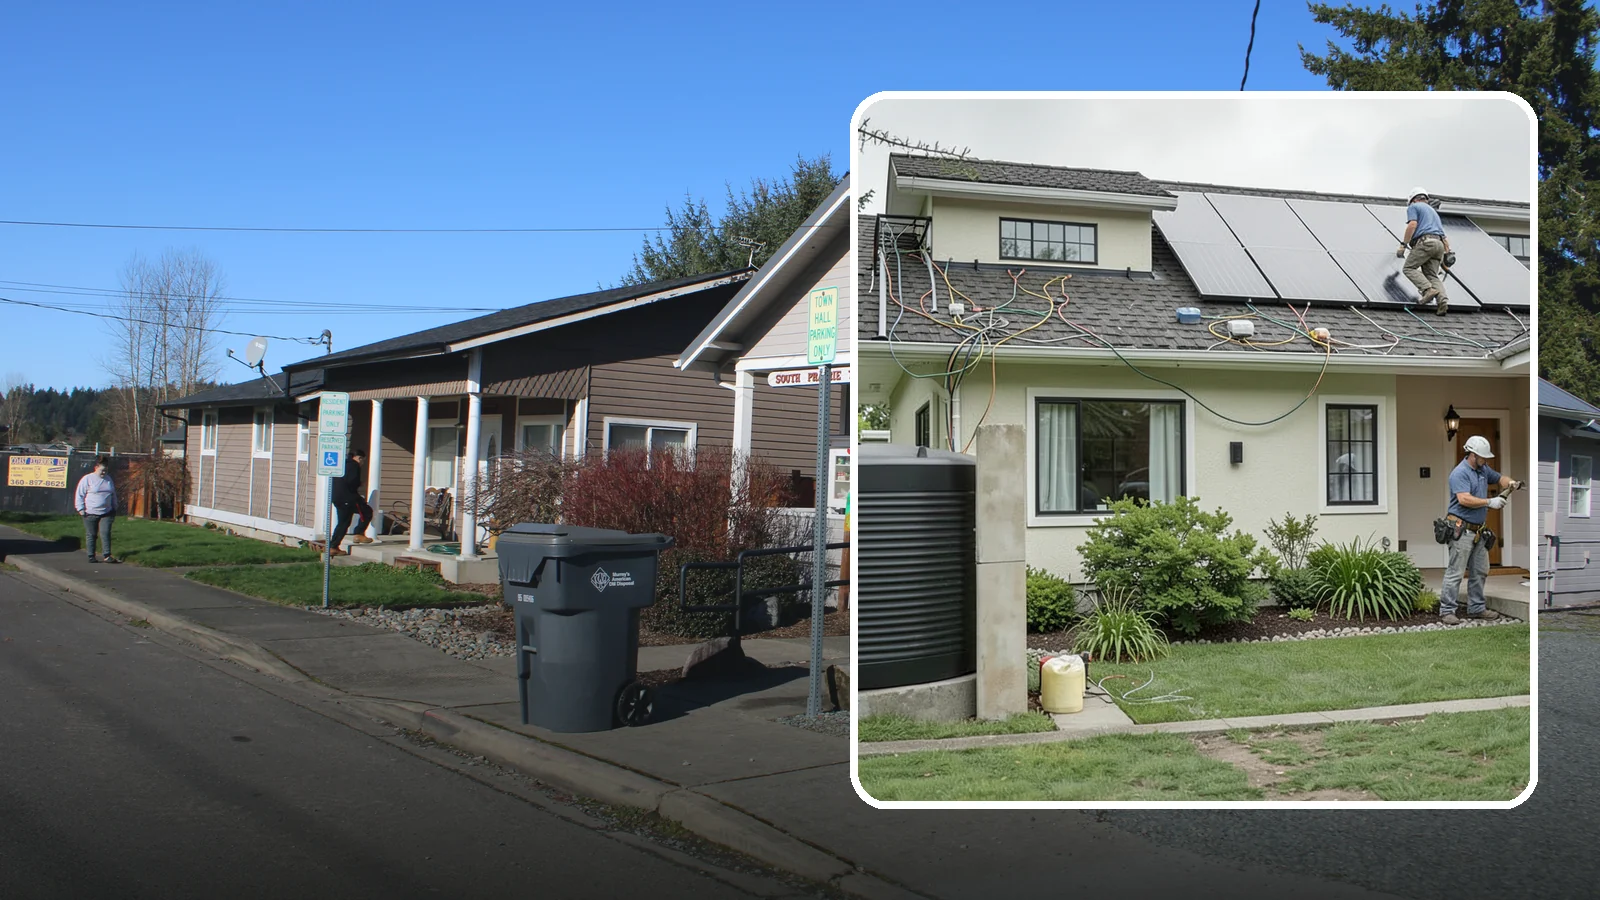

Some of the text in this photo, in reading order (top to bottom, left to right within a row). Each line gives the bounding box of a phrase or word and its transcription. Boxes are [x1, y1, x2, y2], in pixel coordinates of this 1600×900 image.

[815, 295, 833, 308] TOWN
[814, 311, 831, 324] HALL
[809, 326, 836, 341] PARKING
[813, 344, 831, 358] ONLY
[775, 373, 801, 384] SOUTH
[322, 409, 345, 417] PARKING
[325, 420, 340, 428] ONLY
